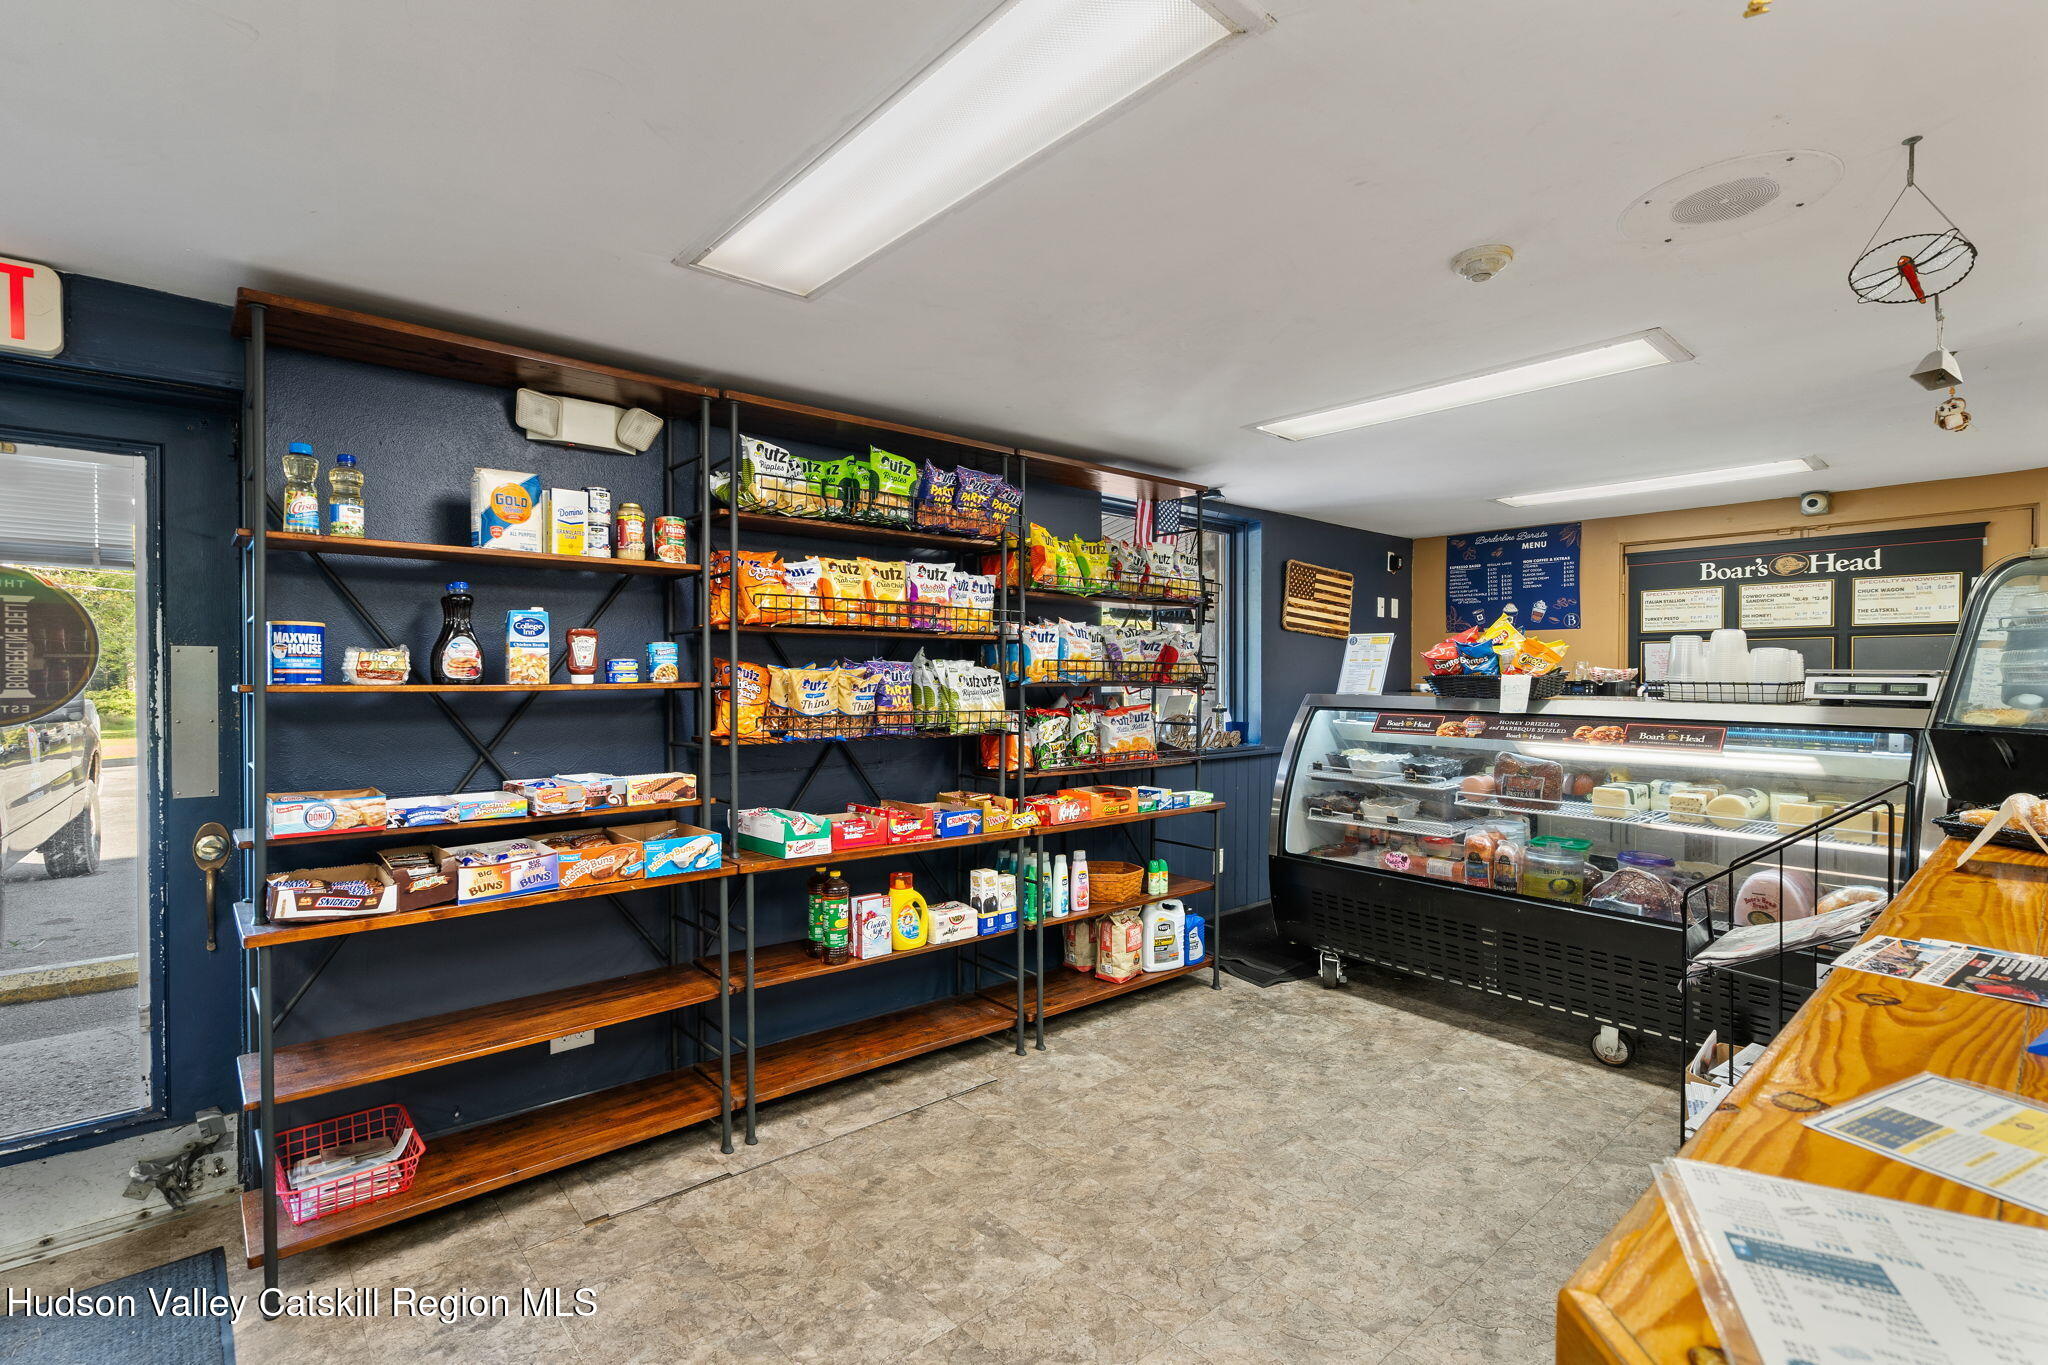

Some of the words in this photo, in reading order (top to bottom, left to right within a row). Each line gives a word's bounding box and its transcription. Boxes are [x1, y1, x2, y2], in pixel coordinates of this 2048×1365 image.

[759, 460, 785, 472] Ripples
[883, 471, 907, 484] Ripples
[930, 484, 955, 497] PARTY
[495, 493, 528, 508] GOLD
[960, 491, 989, 504] PARTY
[291, 501, 317, 514] Crisco
[557, 508, 584, 517] Domino
[991, 498, 1018, 515] PARTY
[1474, 534, 1516, 546] Borderline
[1516, 530, 1549, 541] Barista
[1521, 540, 1548, 550] MENU
[1699, 557, 1769, 581] Boar's
[1808, 549, 1883, 574] Head
[514, 622, 544, 631] College
[1567, 616, 1577, 626] B
[273, 632, 322, 644] MAXWELL
[287, 644, 322, 655] HOUSE
[1460, 656, 1489, 666] Doritos
[886, 684, 912, 696] PARTY
[801, 698, 830, 711] Thins
[1386, 719, 1405, 728] Boar's
[1638, 732, 1666, 740] Boar's
[1680, 734, 1706, 743] Head
[479, 800, 511, 810] Cosmic
[308, 812, 332, 822] DONUT
[474, 807, 516, 818] Brownies
[948, 815, 972, 827] CRUNCH
[892, 821, 922, 836] Skittles
[794, 840, 816, 853] Combos
[650, 852, 675, 872] Honey
[674, 844, 696, 856] Buns
[478, 869, 493, 878] BIG
[560, 861, 592, 887] Honey
[590, 856, 614, 870] Buns
[520, 872, 552, 888] BUNS
[468, 880, 504, 897] BUNS
[318, 898, 360, 907] SNICKERS
